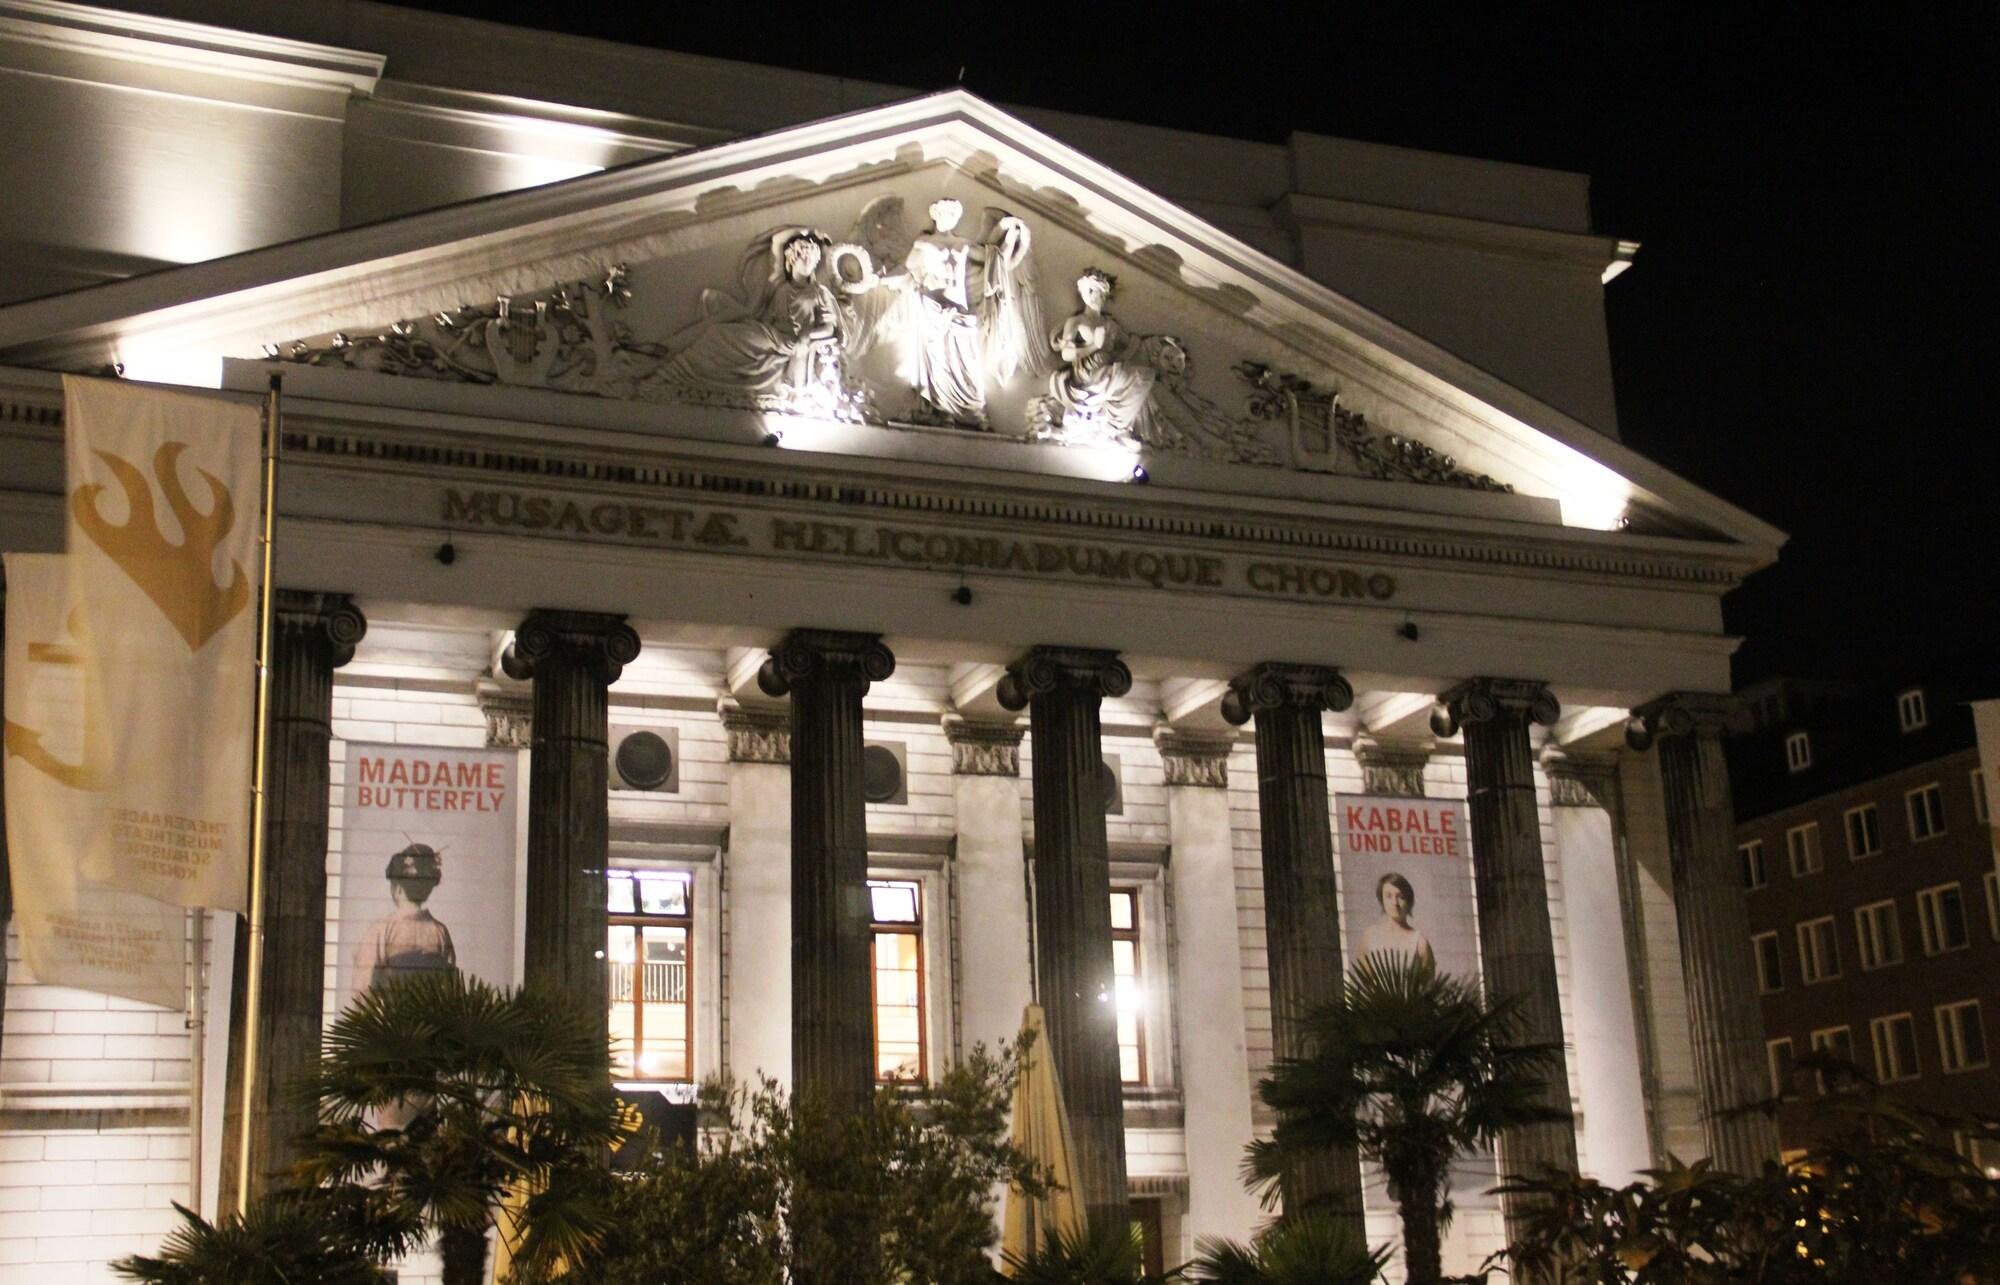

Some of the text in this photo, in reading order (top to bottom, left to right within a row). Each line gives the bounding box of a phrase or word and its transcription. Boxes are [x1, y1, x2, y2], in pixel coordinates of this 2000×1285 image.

[1245, 561, 1397, 600] CHORO
[359, 757, 505, 789] MADAME
[358, 786, 505, 812] BUTTERFLY
[1347, 806, 1457, 835] KABALE
[1349, 833, 1459, 857] UND LIEBE
